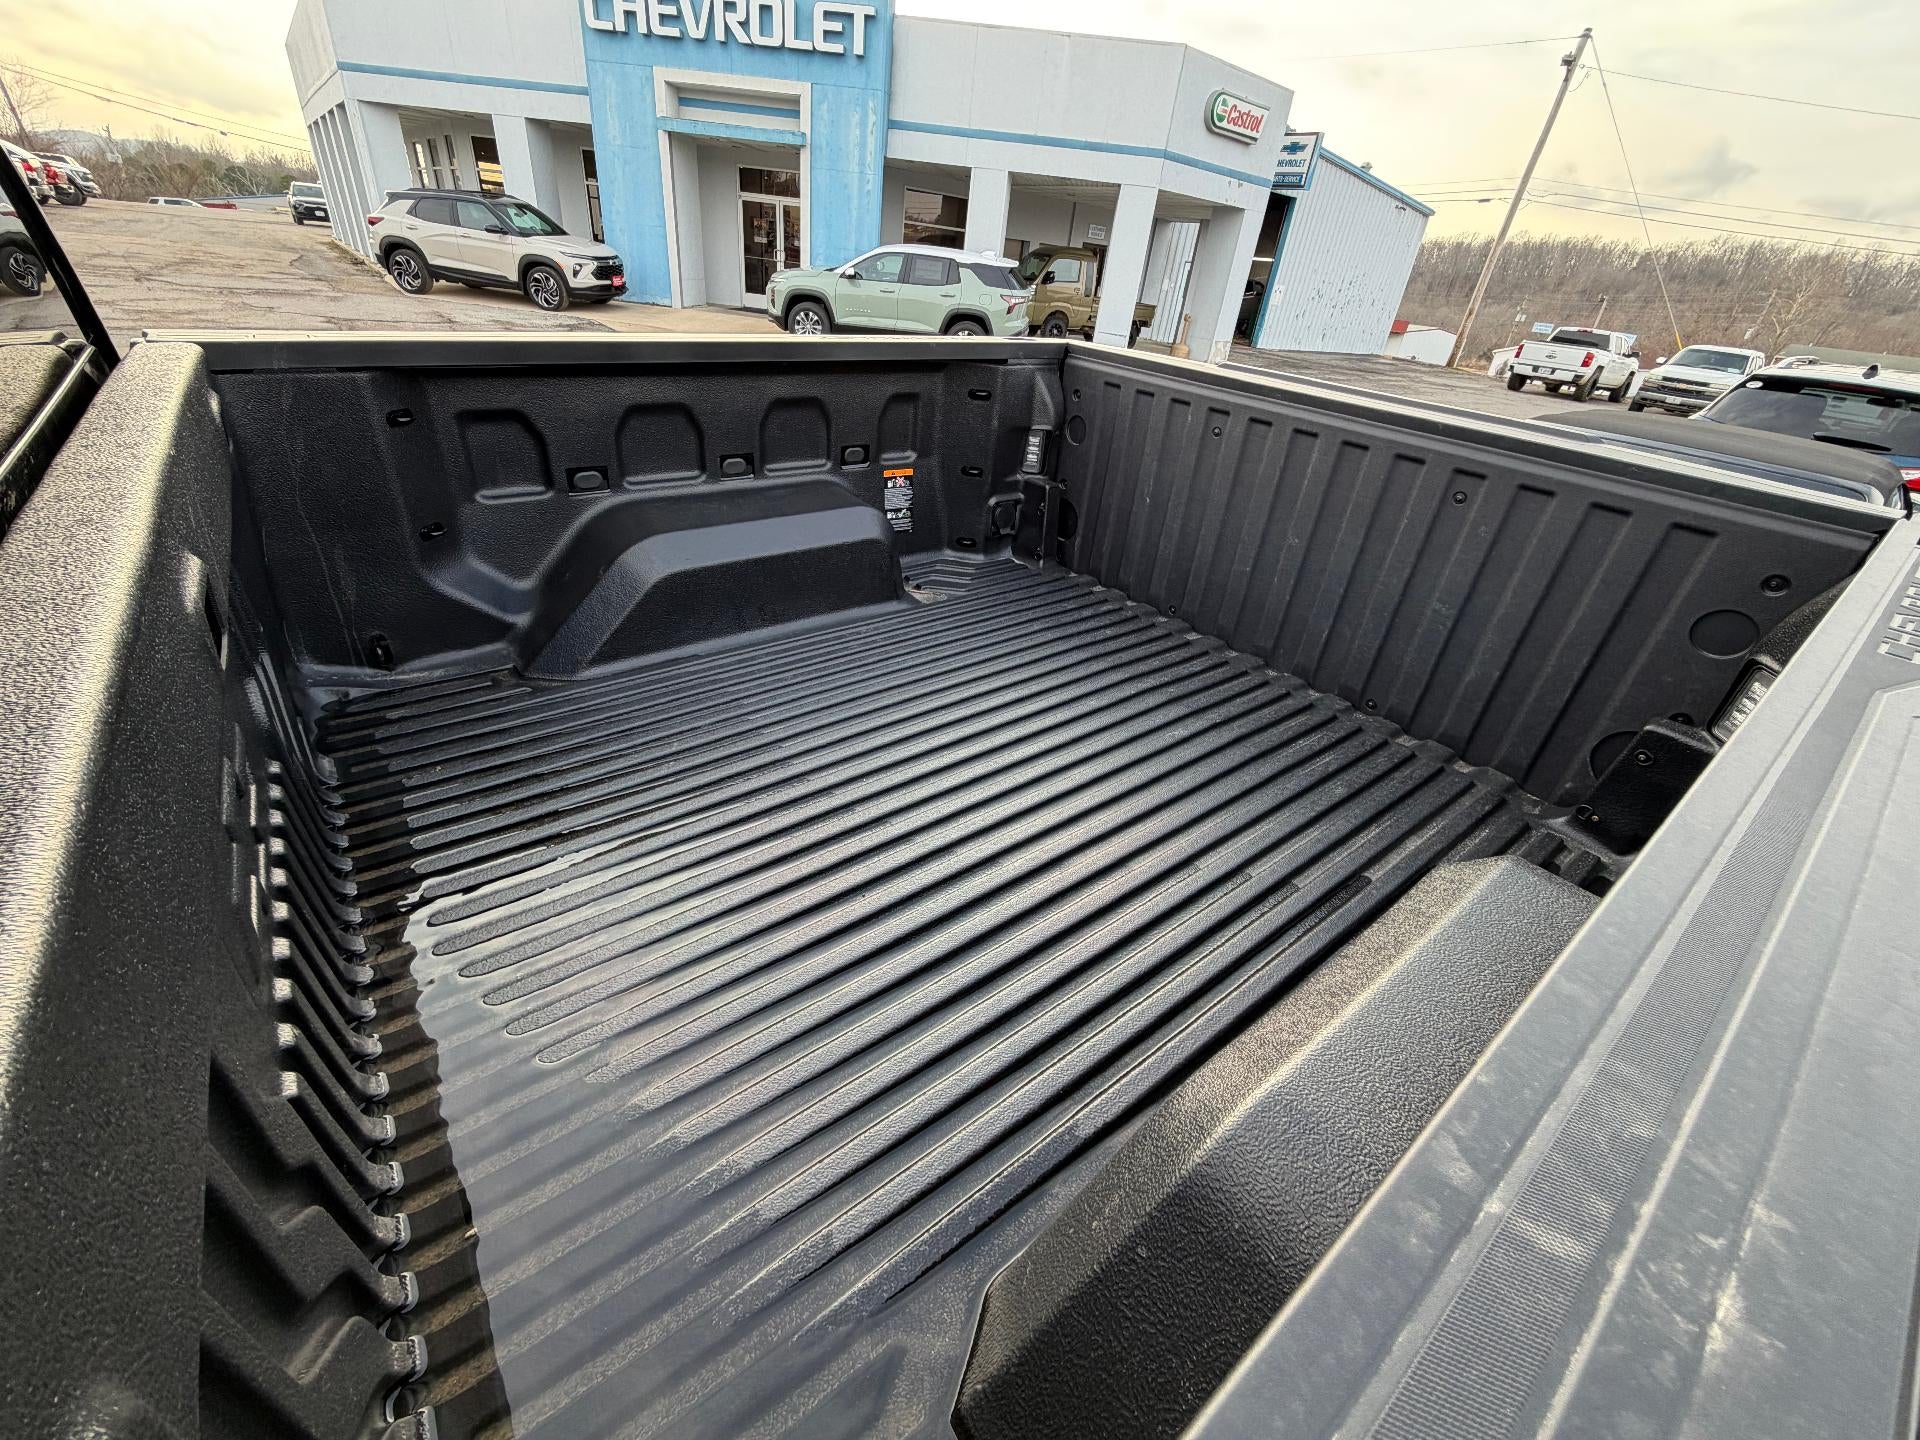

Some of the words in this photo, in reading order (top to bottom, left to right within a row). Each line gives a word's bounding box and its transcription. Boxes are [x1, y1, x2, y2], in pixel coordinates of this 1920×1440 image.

[583, 0, 876, 56] CHEVROLET
[1227, 104, 1264, 133] Castrol
[1277, 159, 1306, 168] HEVROLET
